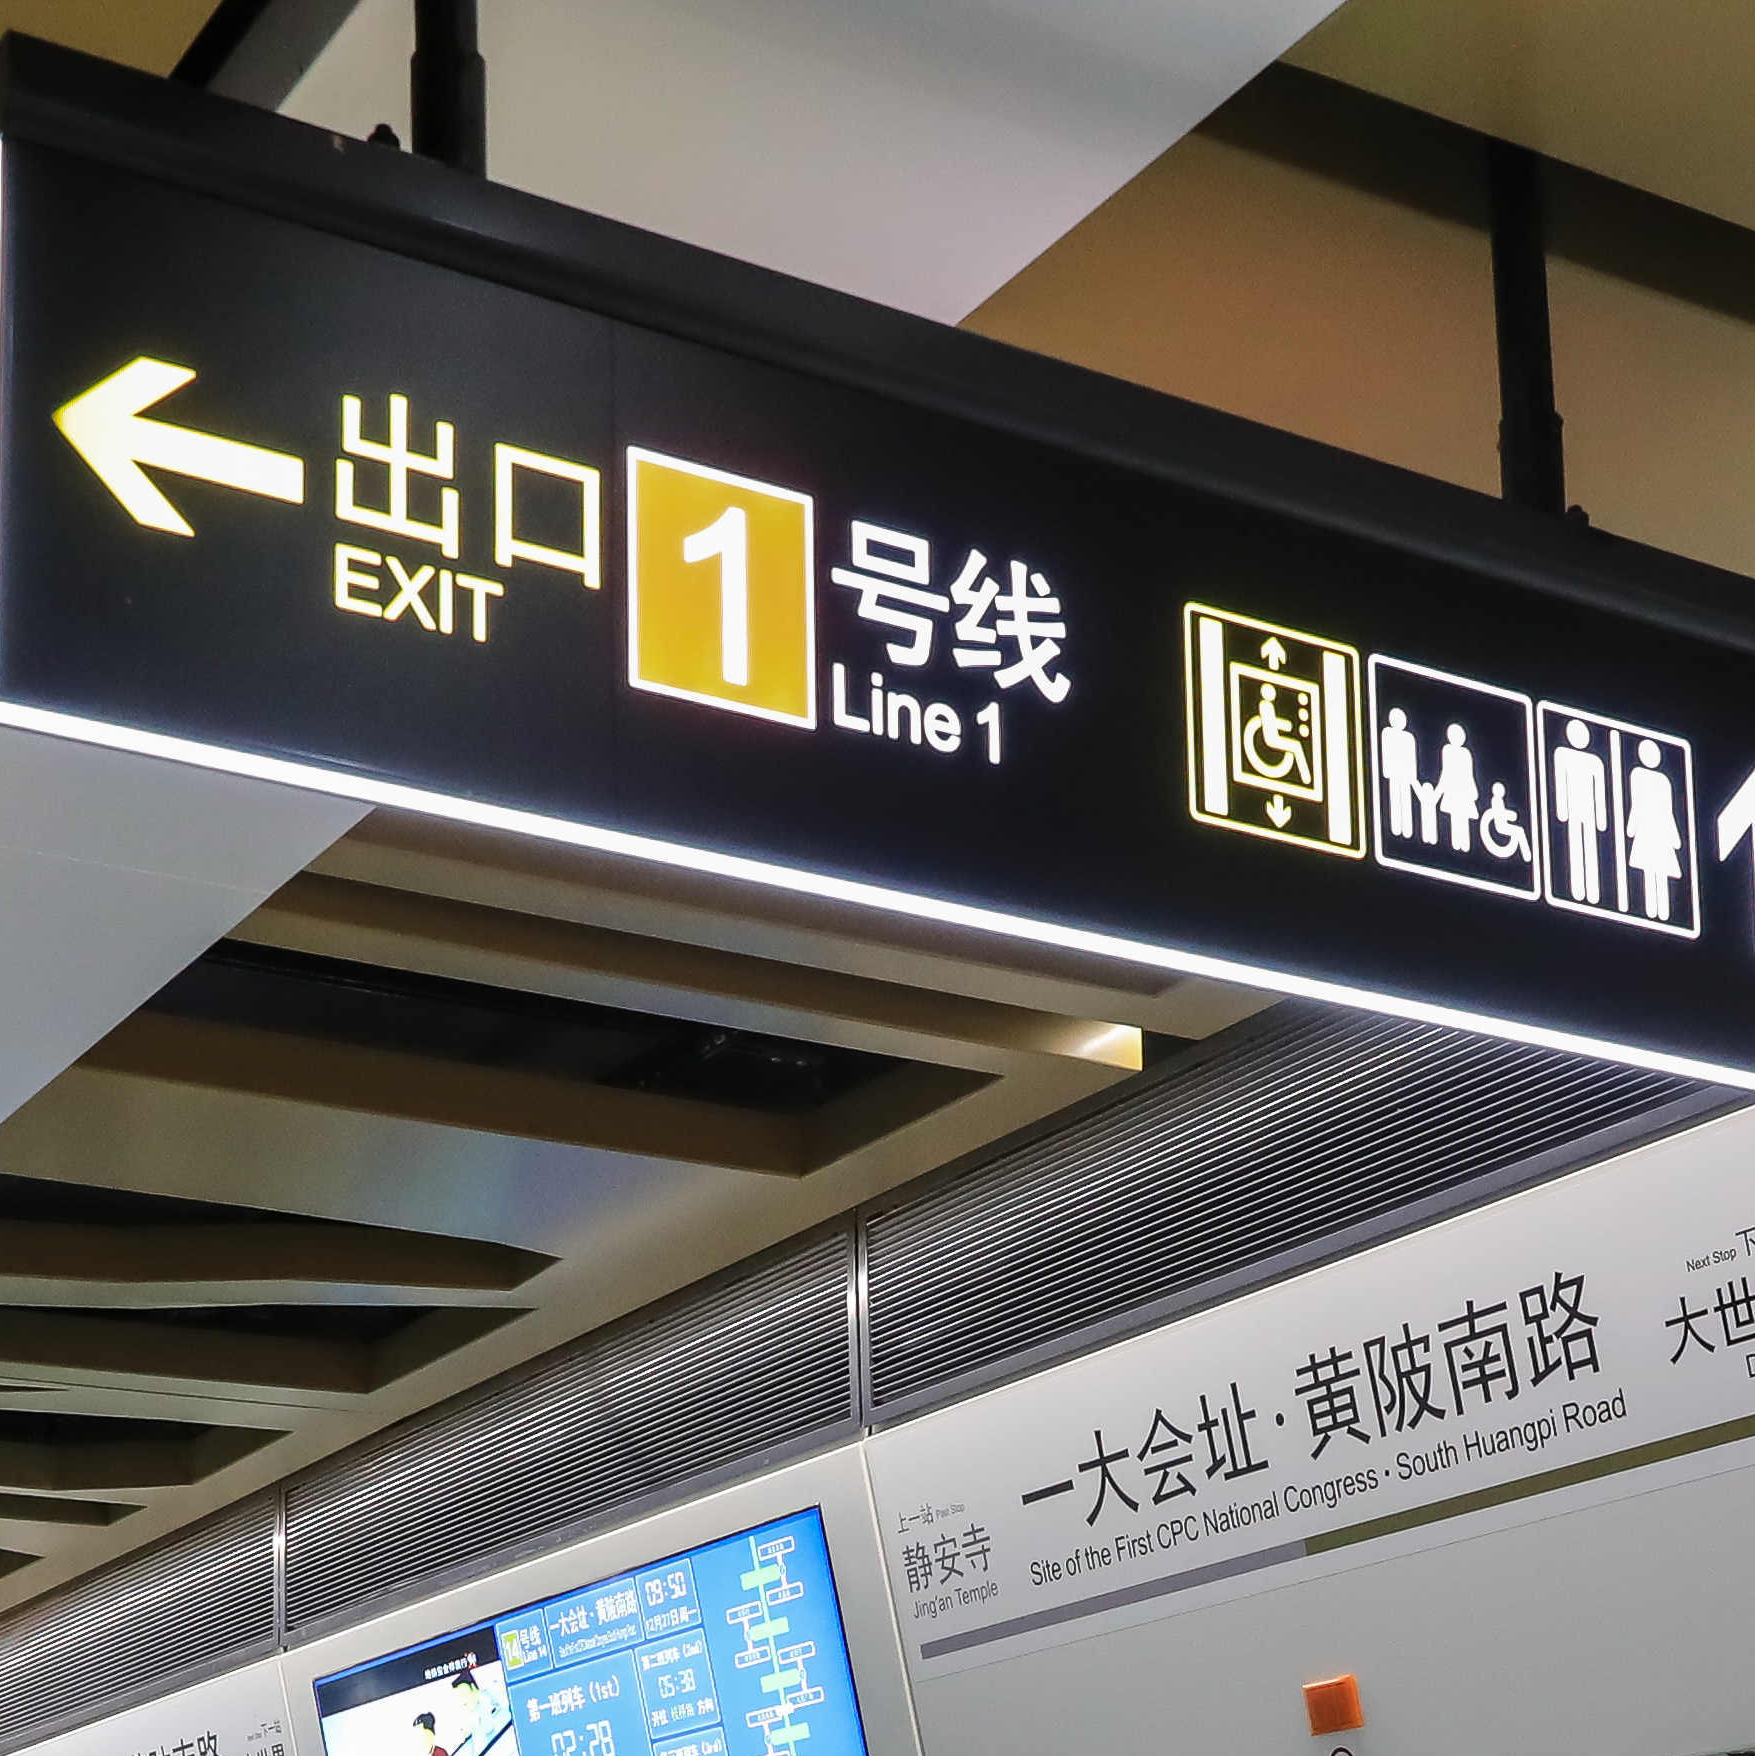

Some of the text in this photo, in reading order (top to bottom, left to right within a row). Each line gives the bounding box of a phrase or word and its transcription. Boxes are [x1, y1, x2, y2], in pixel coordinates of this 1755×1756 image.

[329, 393, 602, 588] 出口
[332, 545, 504, 642] EXIT
[682, 508, 751, 685] 1
[829, 520, 1070, 702] 号线
[832, 664, 1002, 762] Line 1
[1685, 1248, 1737, 1272] Next Stop
[1021, 1270, 1601, 1528] 一大会址·黄陂南路
[898, 1501, 934, 1534] 上一站
[1030, 1388, 1628, 1586] Site of the First CPC National Congress South Huangpi Road
[645, 1572, 687, 1606] 09:50
[902, 1523, 991, 1593] 静安寺
[913, 1580, 999, 1620] Jing'an Temple
